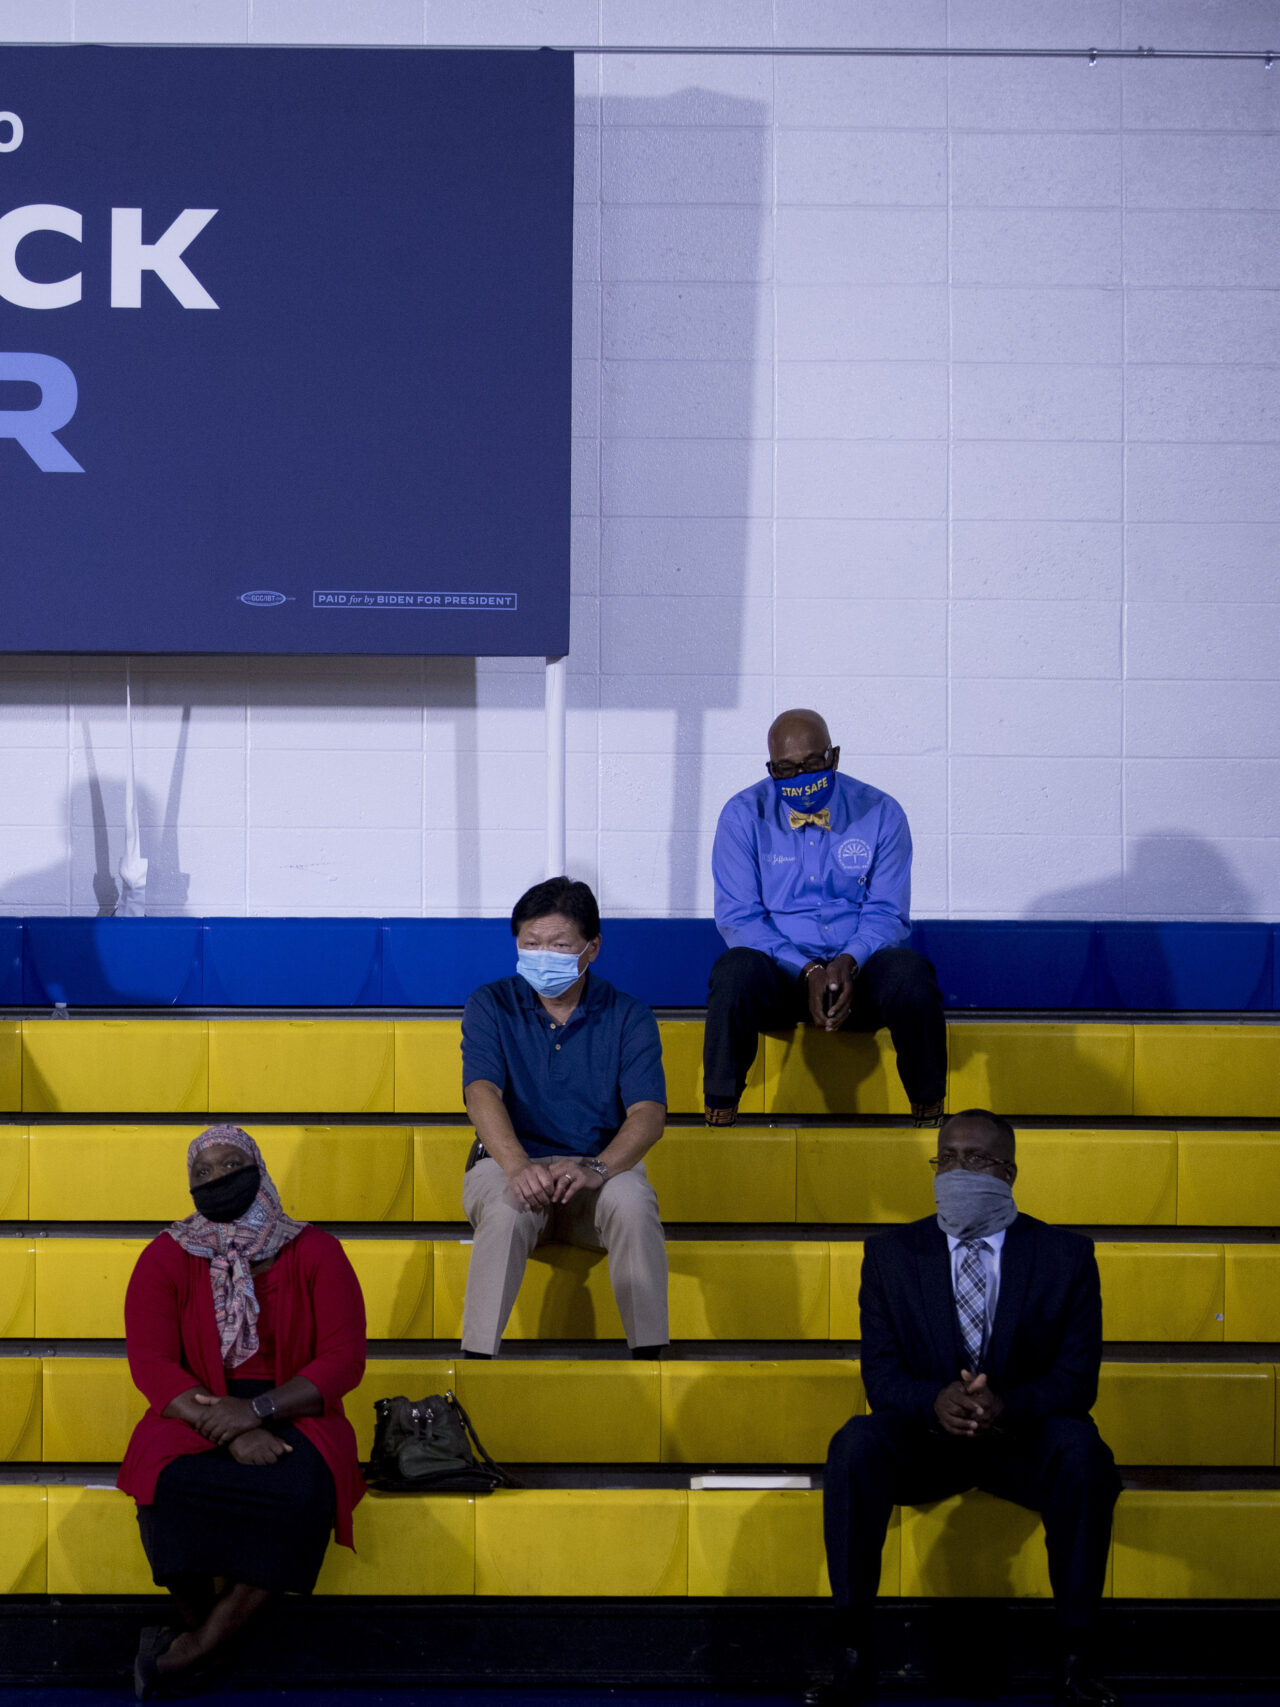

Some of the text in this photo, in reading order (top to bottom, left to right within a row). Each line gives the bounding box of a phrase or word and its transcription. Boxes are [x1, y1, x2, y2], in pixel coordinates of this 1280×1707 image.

[318, 595, 512, 606] PAID for by BIDEN FOR PRESIDENT
[781, 777, 828, 797] STAY SAFE
